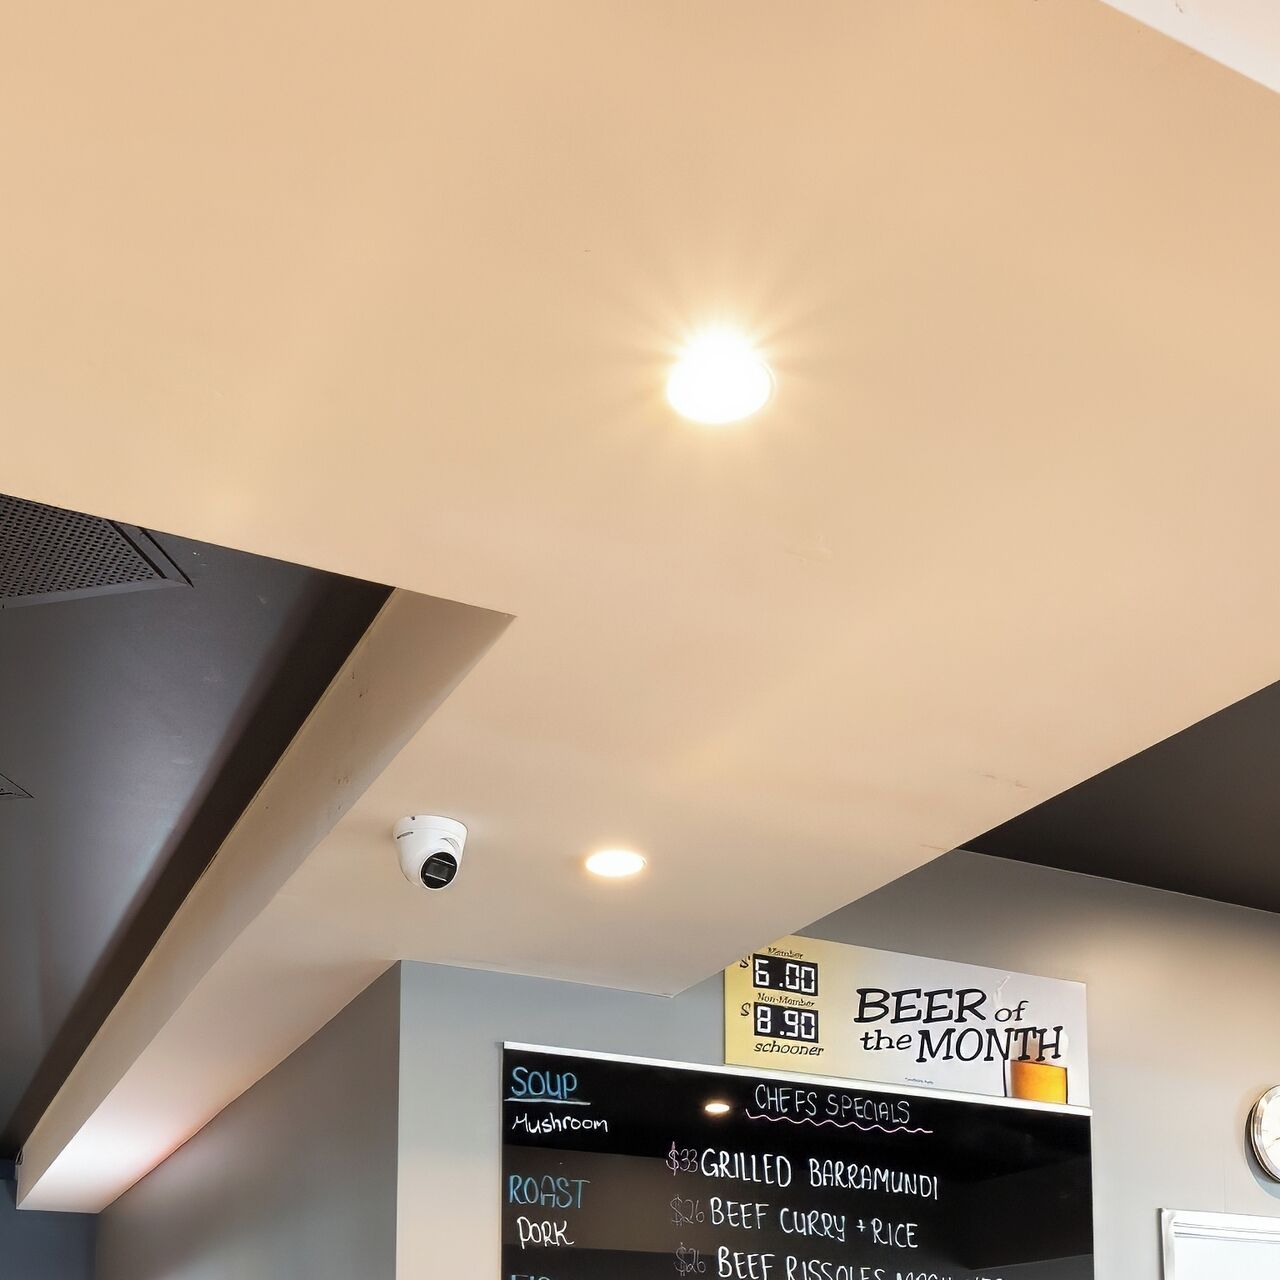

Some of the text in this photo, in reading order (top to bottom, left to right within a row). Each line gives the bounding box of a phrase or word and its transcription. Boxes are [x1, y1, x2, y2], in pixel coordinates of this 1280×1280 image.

[853, 987, 1029, 1024] BEER of
[753, 1040, 824, 1057] schooner
[859, 1025, 1064, 1064] the MONTH
[511, 1066, 578, 1099] SOUP
[754, 1083, 911, 1124] CHEFS SPECIALS
[511, 1112, 609, 1134] Mushroom
[508, 1174, 590, 1208] ROAST
[700, 1147, 792, 1188] GRILLED
[808, 1157, 939, 1200] BARRAMUNDI
[516, 1215, 575, 1250] PORK
[709, 1196, 770, 1230] BEEF
[779, 1205, 846, 1243] CURRY
[872, 1218, 919, 1248] RICE
